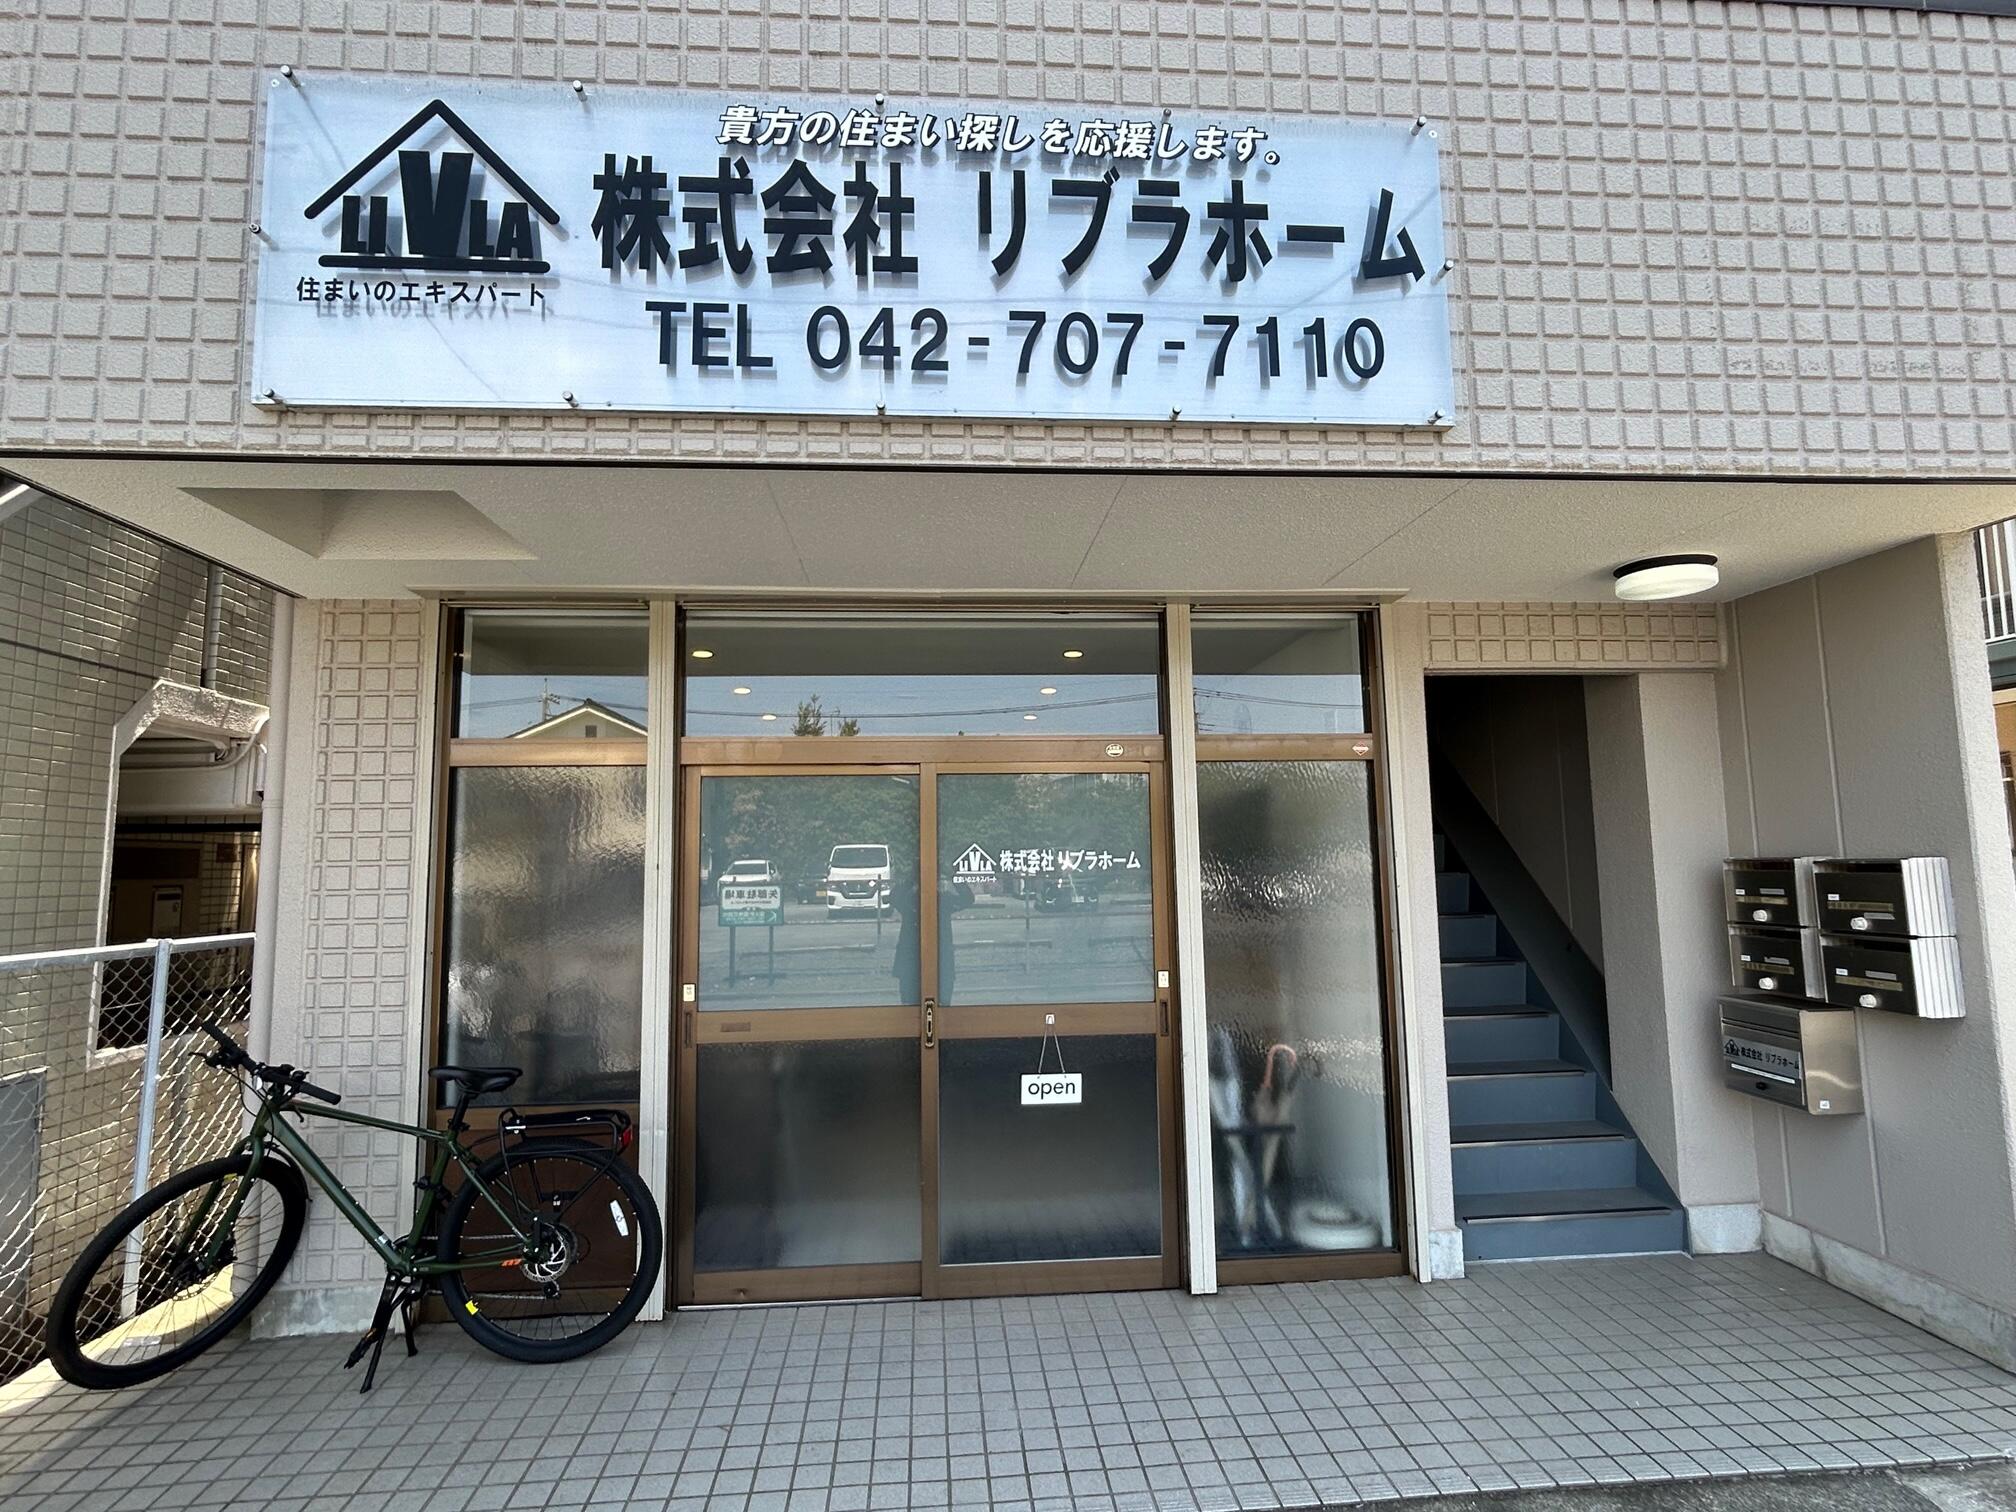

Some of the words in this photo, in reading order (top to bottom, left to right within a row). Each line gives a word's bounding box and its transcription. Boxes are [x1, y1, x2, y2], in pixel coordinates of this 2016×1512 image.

[715, 105, 1280, 165] 貴方の住まい探しを応援します。
[590, 154, 919, 276] 株式会社
[978, 166, 1425, 282] リブラホーム
[296, 276, 545, 307] 住まいのエキスパート
[645, 301, 774, 368] TEL
[999, 849, 1055, 872] 株式会社
[1057, 850, 1141, 871] リブラホーム
[1028, 1082, 1075, 1100] open
